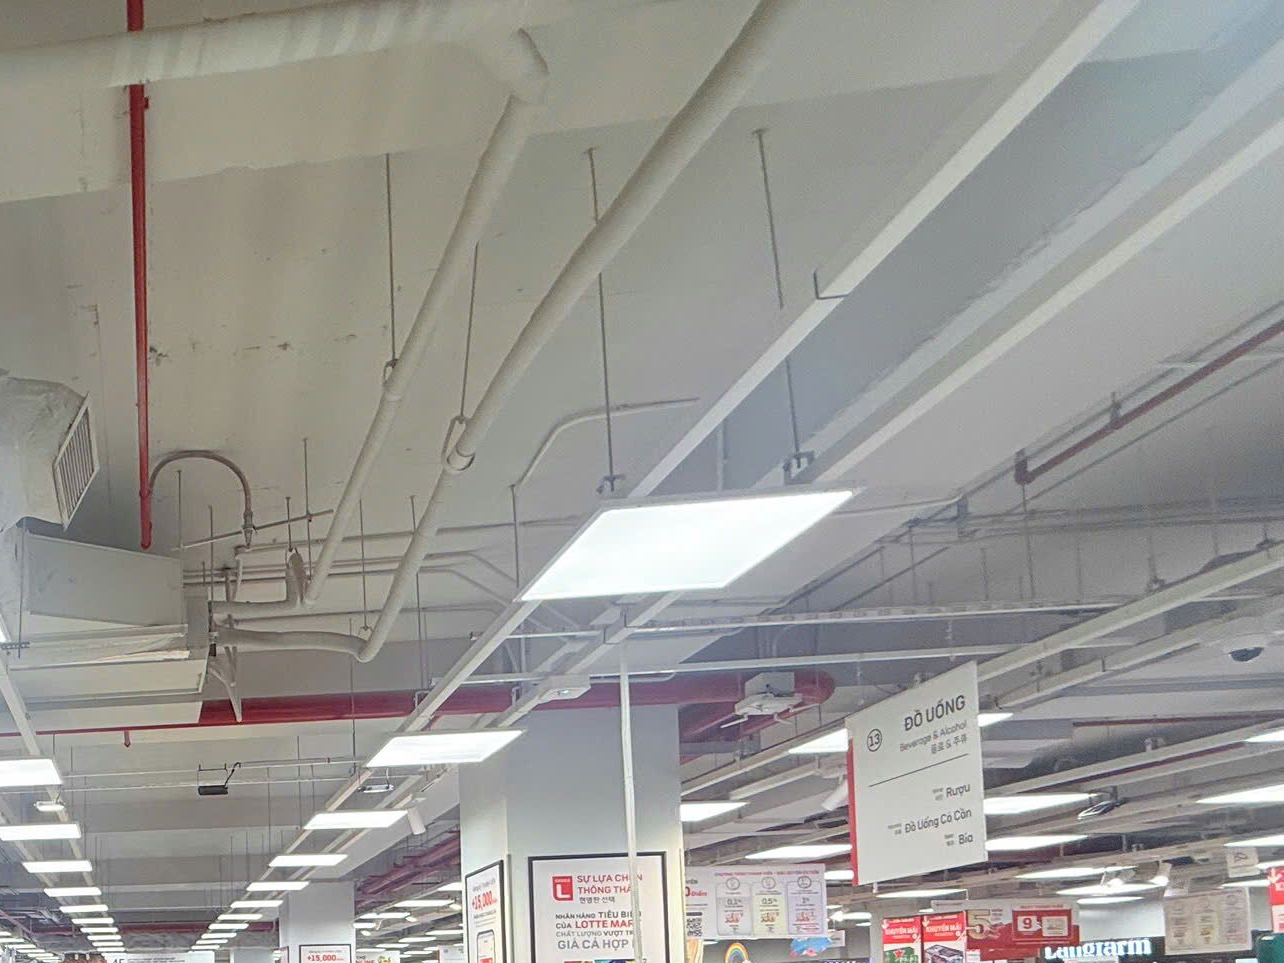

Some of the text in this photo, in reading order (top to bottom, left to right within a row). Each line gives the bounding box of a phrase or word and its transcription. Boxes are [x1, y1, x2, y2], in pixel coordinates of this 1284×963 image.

[904, 694, 965, 731] ĐỒ UỐNG
[940, 719, 967, 737] Alcohol
[868, 733, 880, 748] 13
[945, 782, 970, 799] Rượu
[917, 815, 939, 831] Uống
[940, 810, 952, 825] Có
[615, 873, 643, 882] CHN
[578, 886, 611, 895] THÔNG
[598, 910, 619, 918] TIÊU
[576, 920, 608, 929] LOTTE
[1022, 917, 1032, 930] 9
[557, 938, 580, 950] GIÁ
[602, 939, 629, 951] HỢP
